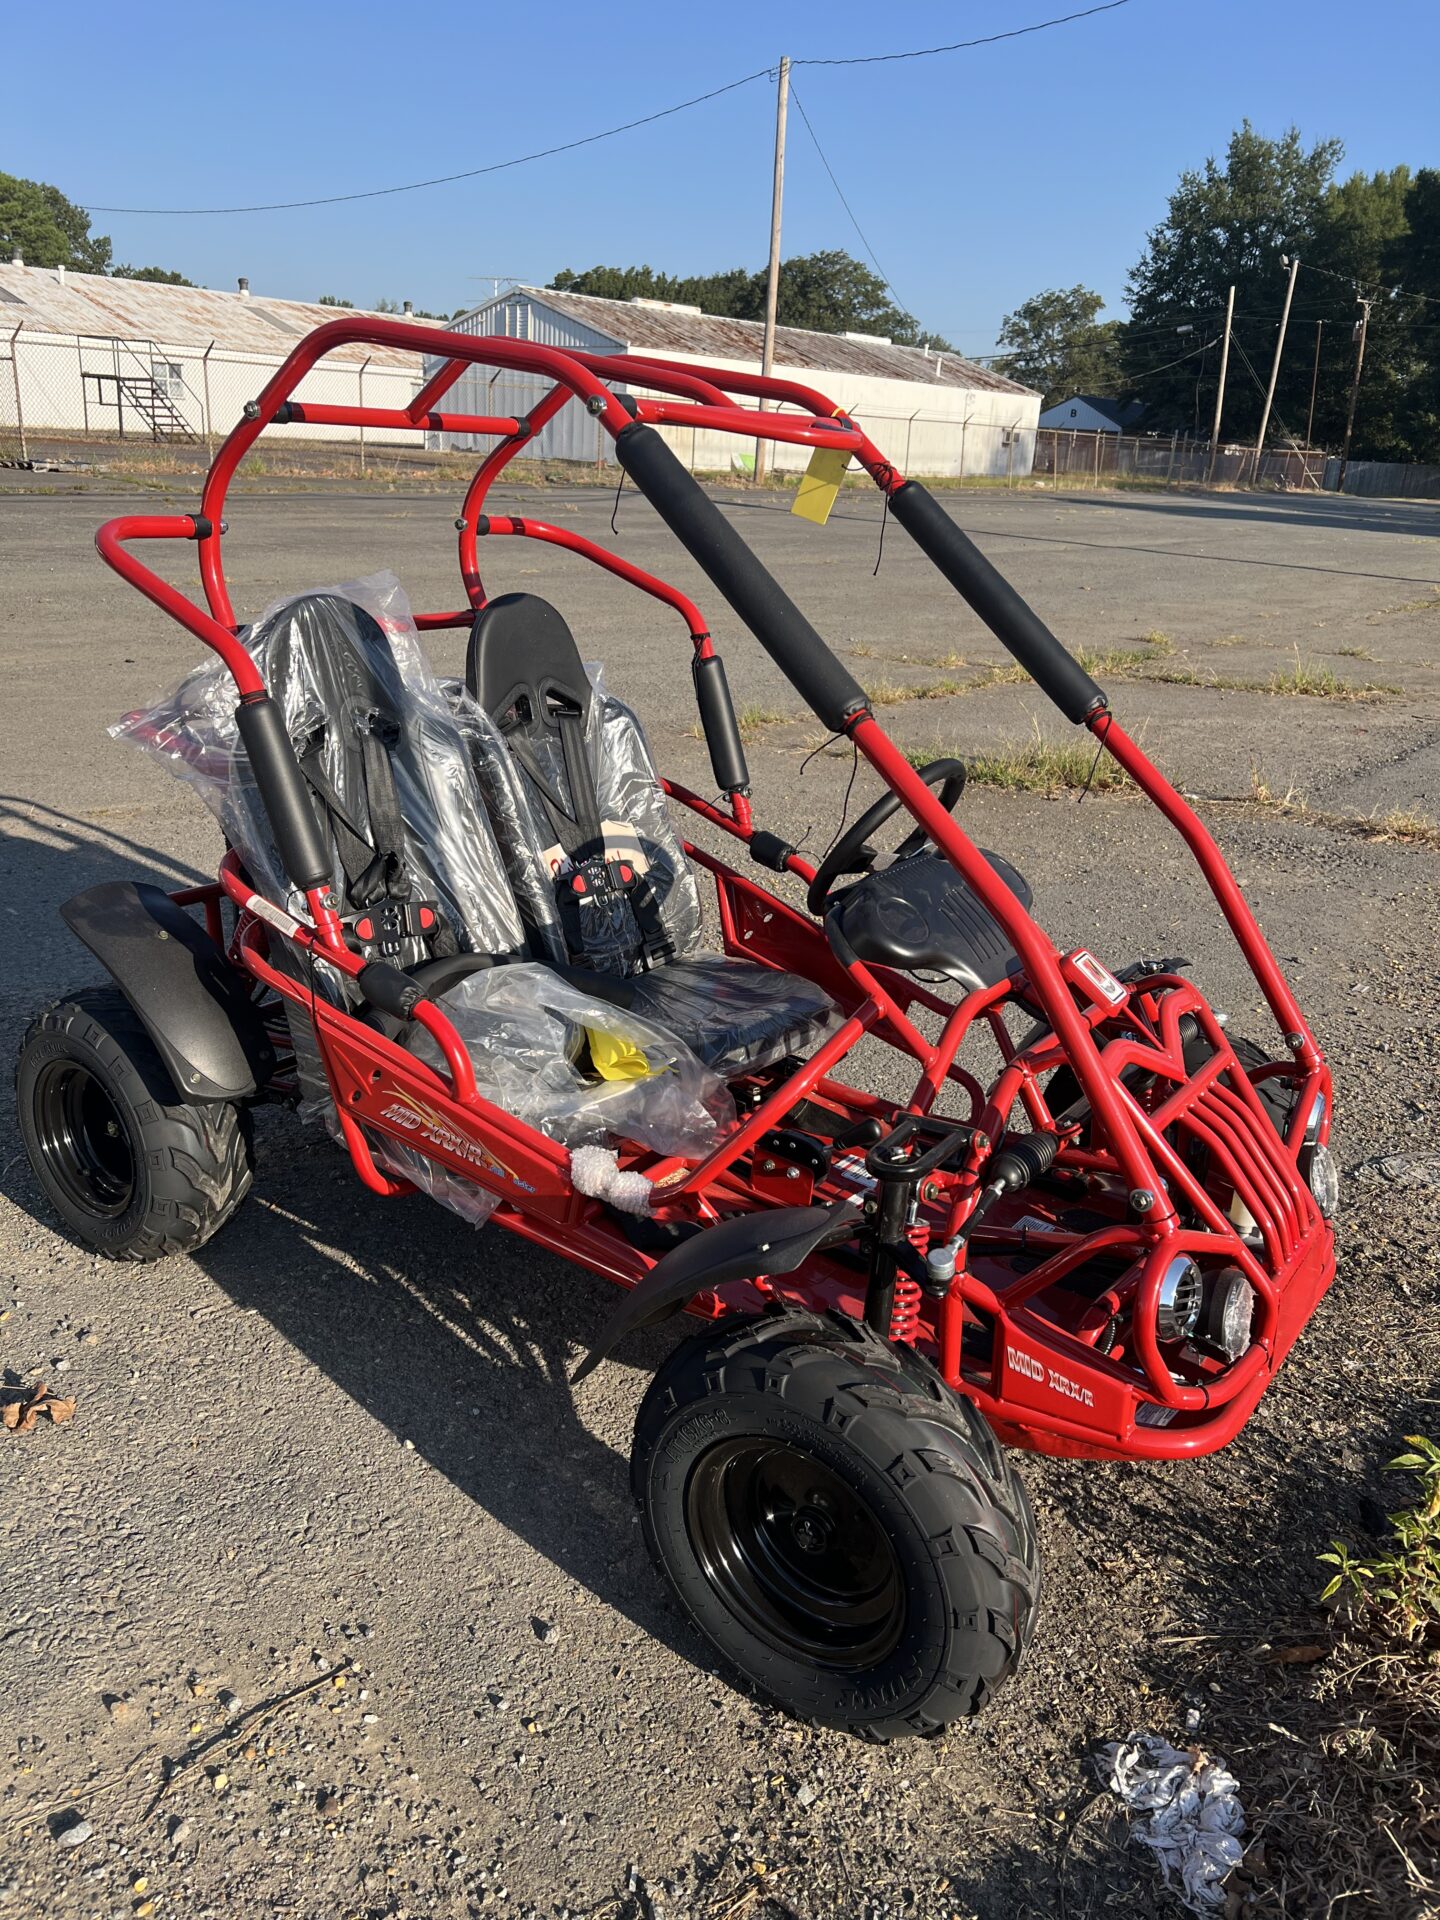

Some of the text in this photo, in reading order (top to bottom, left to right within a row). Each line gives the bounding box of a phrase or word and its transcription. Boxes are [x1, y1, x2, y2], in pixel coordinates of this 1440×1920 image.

[1070, 408, 1077, 418] B
[380, 1103, 422, 1130] MID
[1007, 1346, 1045, 1383] MID
